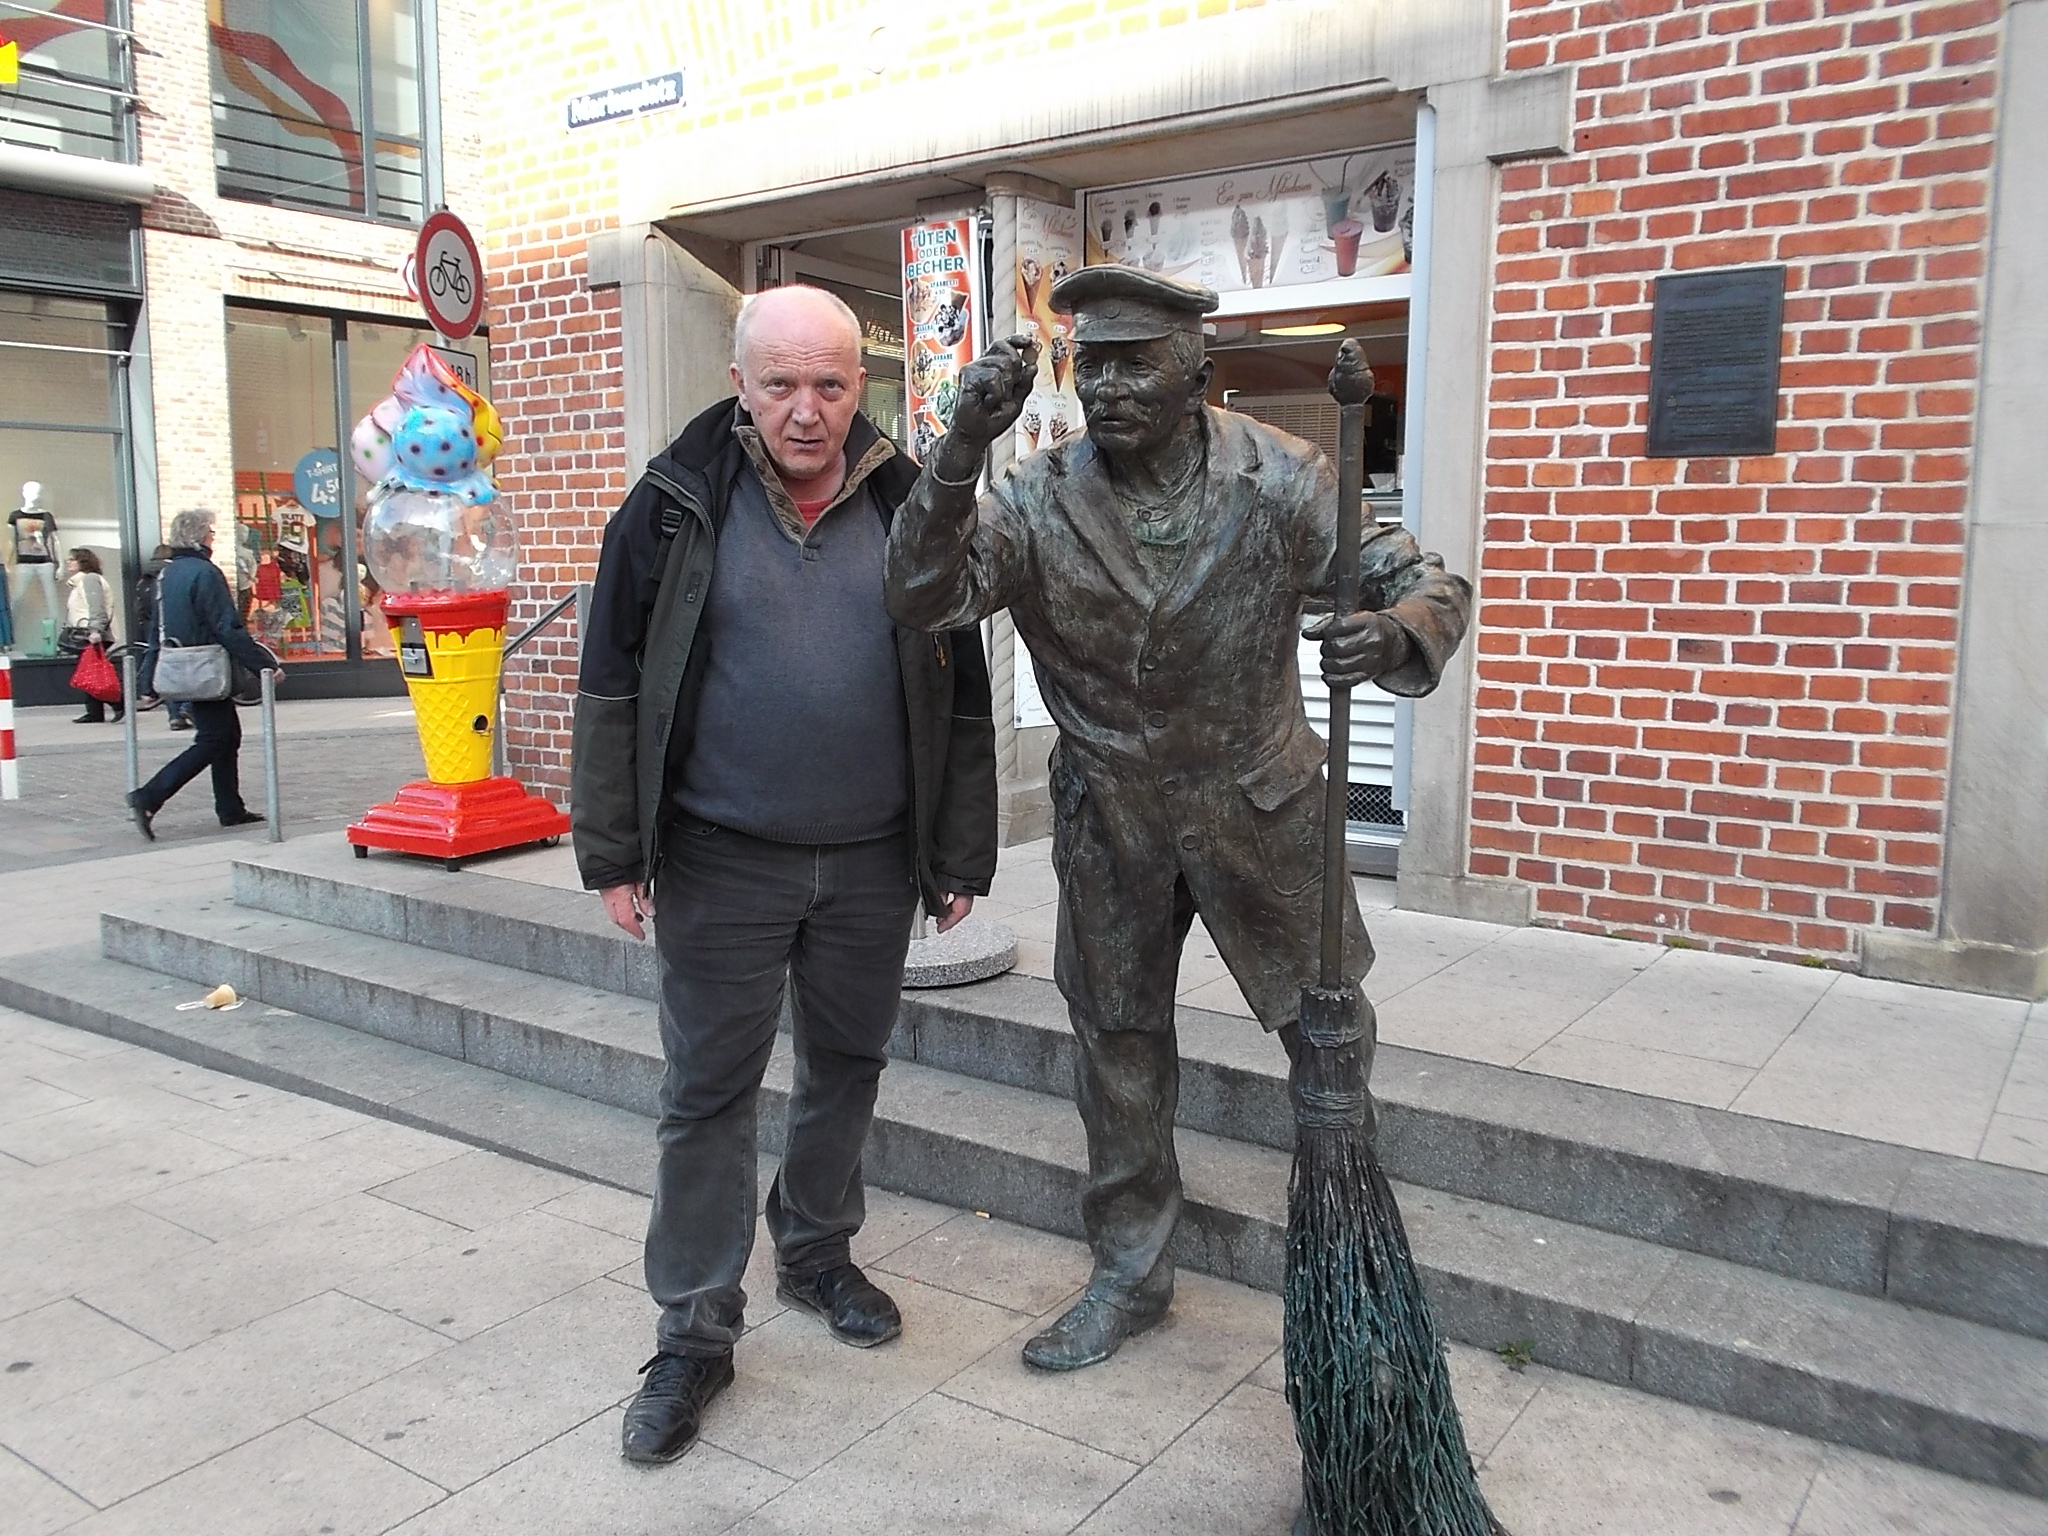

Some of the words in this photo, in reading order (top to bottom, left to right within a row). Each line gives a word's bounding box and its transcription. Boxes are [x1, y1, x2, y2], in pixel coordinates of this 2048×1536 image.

[912, 228, 957, 248] TÜTEN
[918, 246, 947, 259] ODER
[907, 256, 965, 279] BECHER
